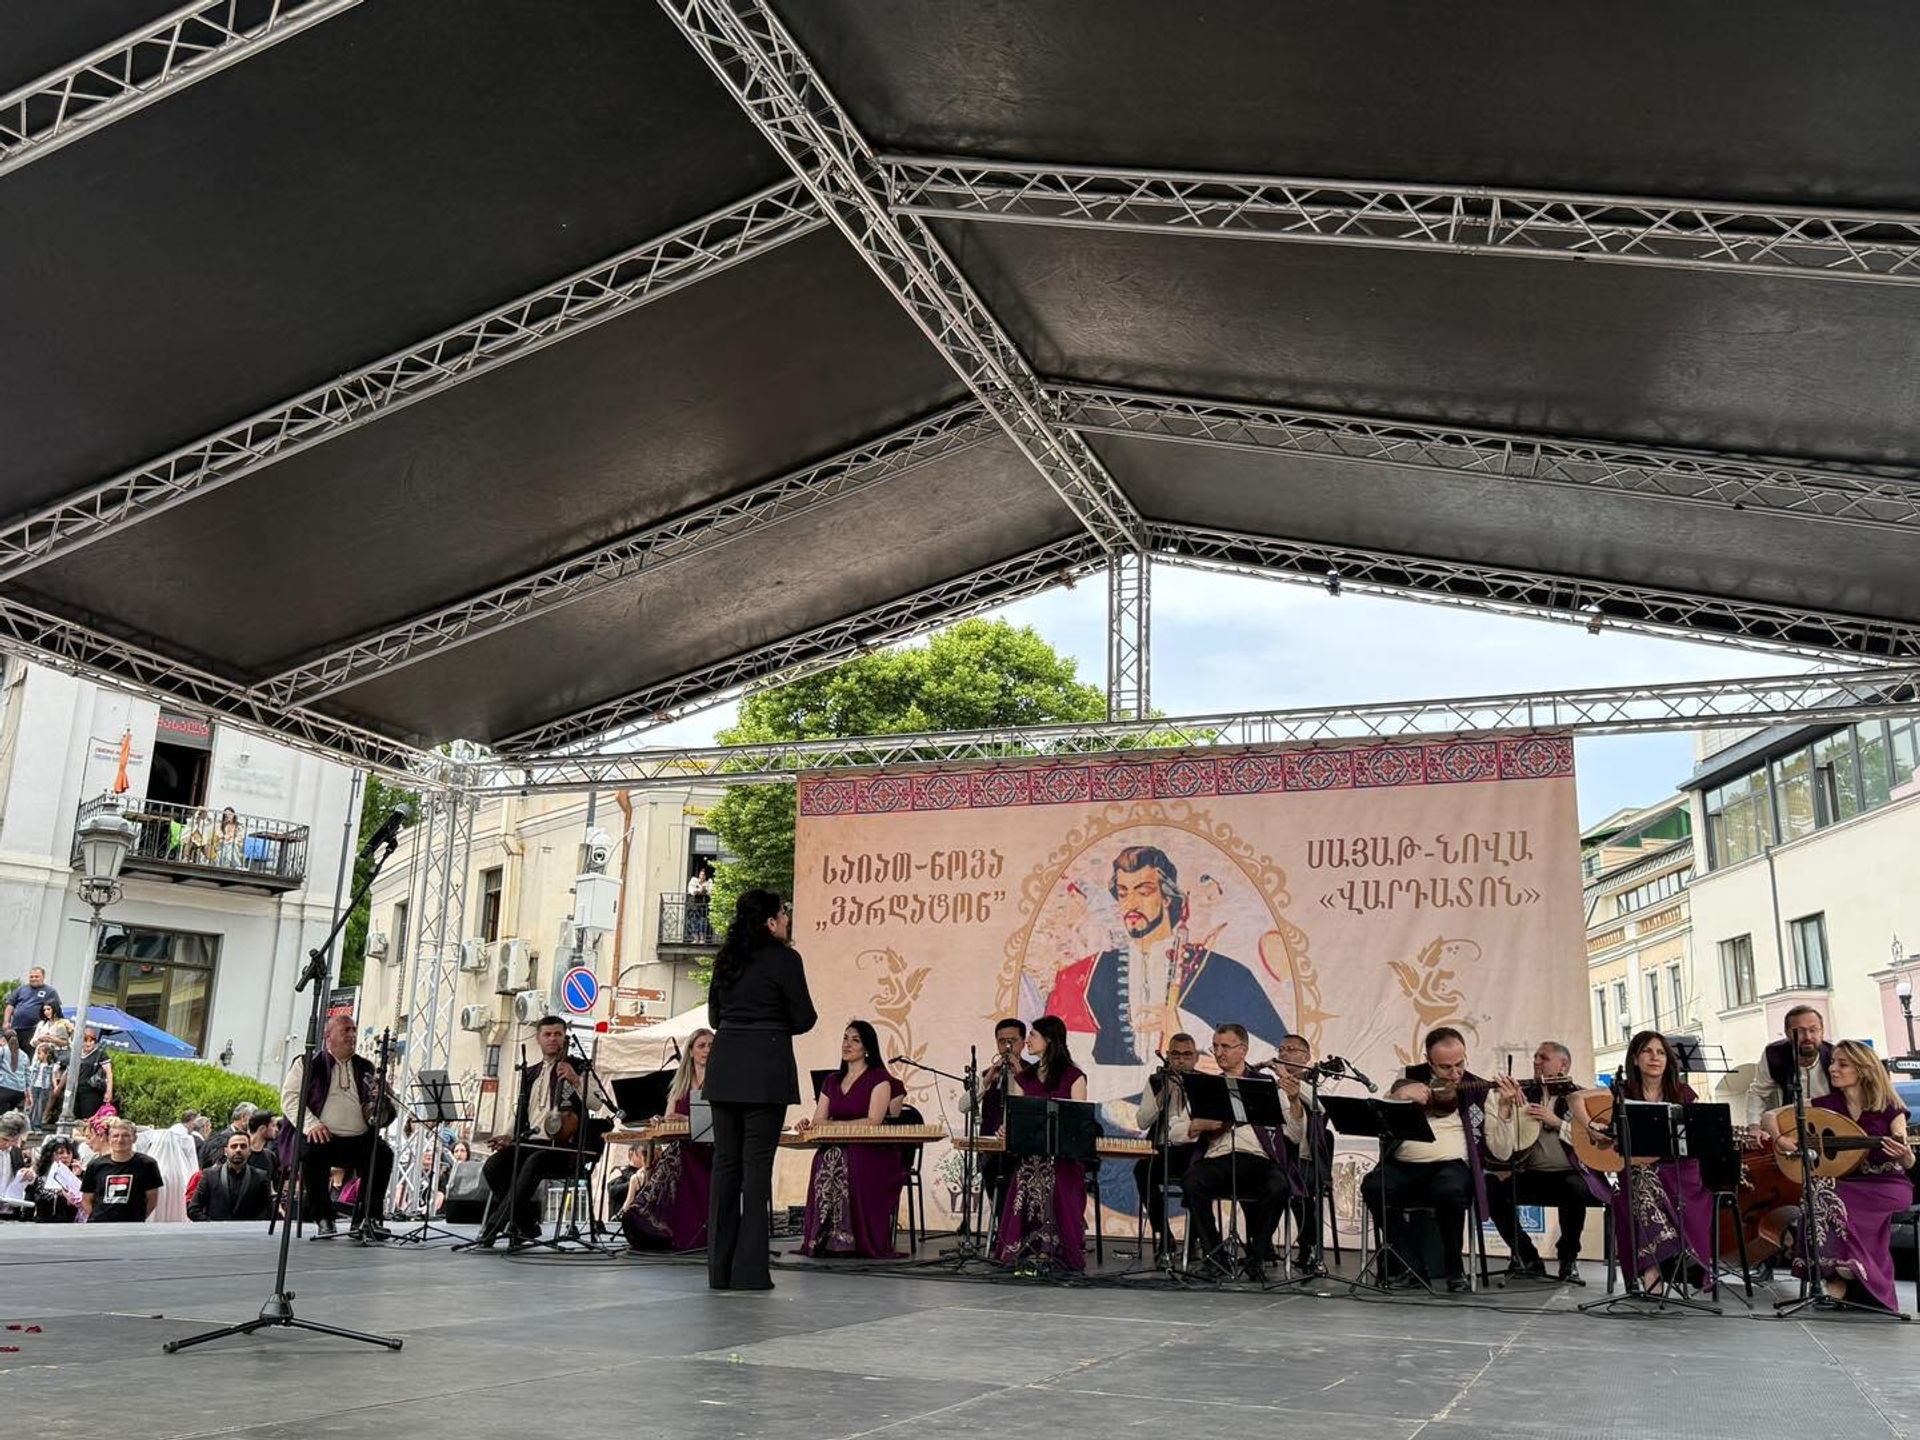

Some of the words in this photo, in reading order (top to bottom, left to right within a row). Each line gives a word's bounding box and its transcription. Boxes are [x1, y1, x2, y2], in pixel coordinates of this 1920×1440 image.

[822, 848, 1004, 885] საიათ-ნოვა
[1307, 830, 1533, 869] ՍԱՅԱԹ-ՆՈՎԱ
[1319, 876, 1541, 915] «ՎԱՐԴԱՏՈՆ»
